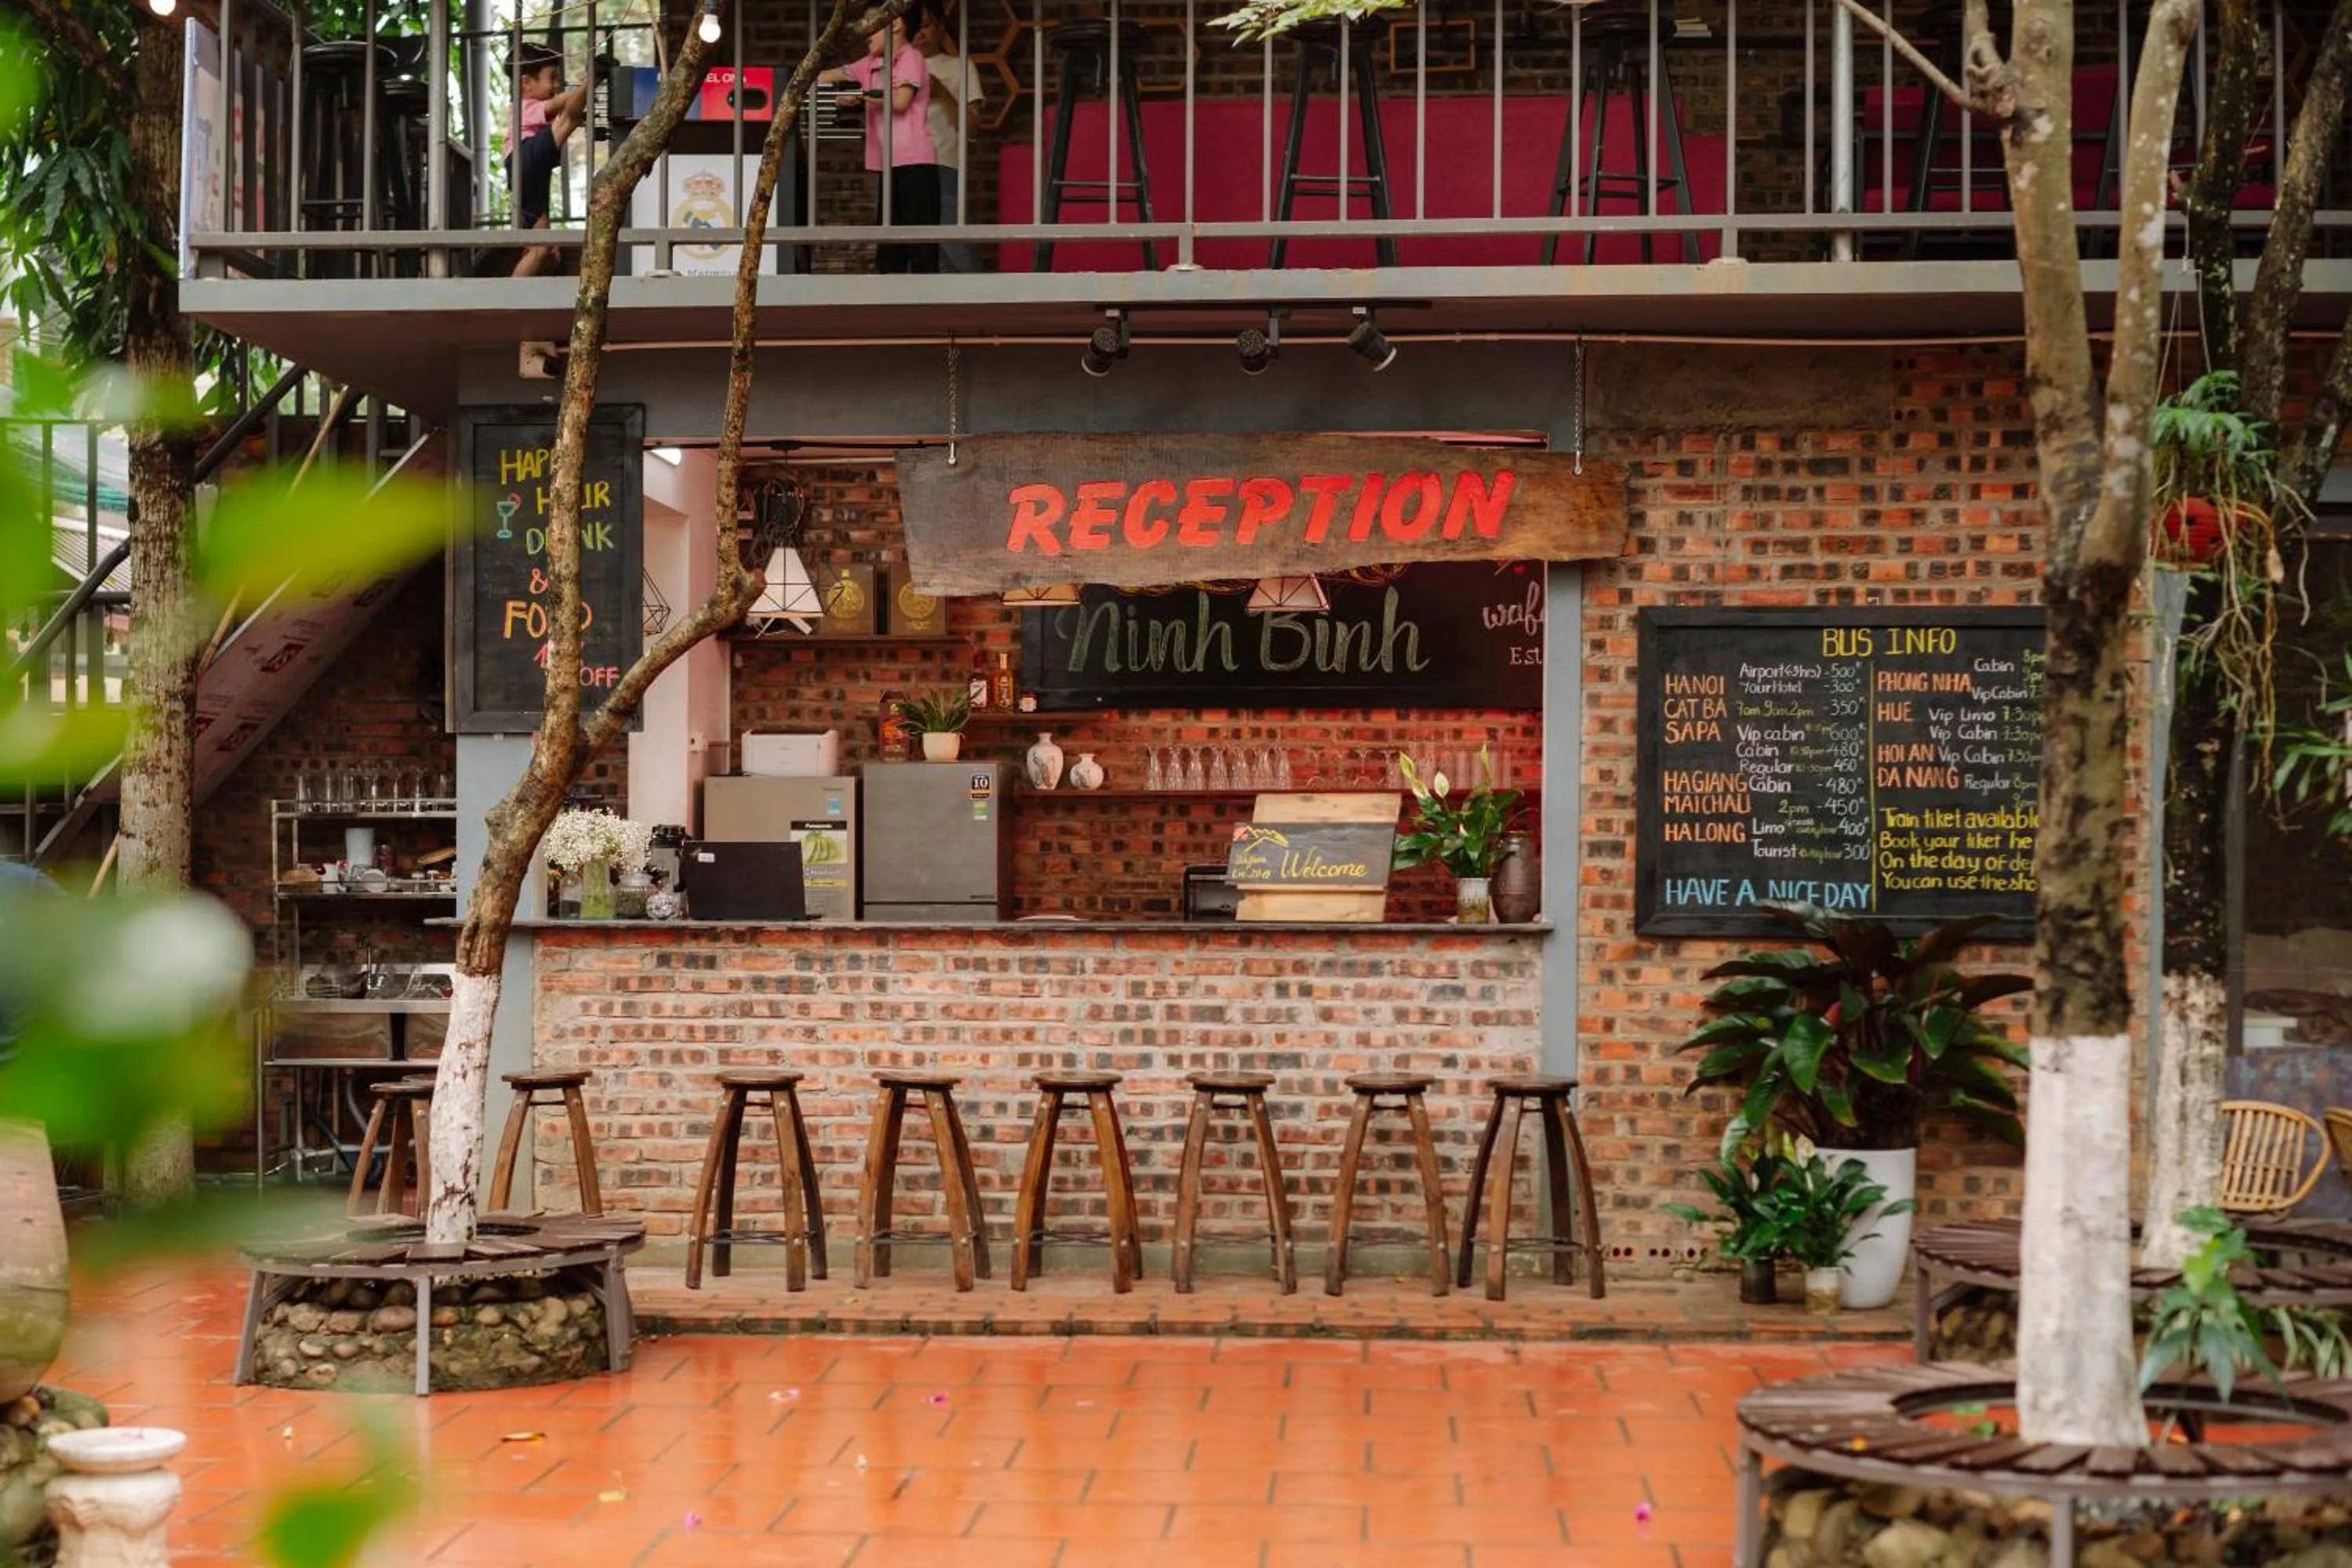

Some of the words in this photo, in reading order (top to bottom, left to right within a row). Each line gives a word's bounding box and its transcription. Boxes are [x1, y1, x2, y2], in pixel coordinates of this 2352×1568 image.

[1007, 470, 1515, 555] RECEPTION
[1822, 628, 1872, 657] BUS
[1884, 628, 1956, 655] INFO
[1974, 659, 2014, 672] Cabin
[580, 666, 620, 688] OFF
[1664, 673, 1725, 695] HANOI
[1878, 670, 1928, 691] PHONG
[1933, 672, 1973, 692] NHA
[1664, 699, 1700, 719] CAT
[1702, 699, 1727, 718] BA
[1878, 702, 1915, 722] HUE
[1929, 708, 1955, 725] Vip
[1961, 707, 1996, 722] Limo
[1664, 720, 1722, 744] SAPA
[1737, 724, 1761, 746] Vip
[1929, 725, 1951, 744] Vip
[1958, 724, 1997, 741] Cabin
[1736, 742, 1779, 758] Cabin
[1878, 743, 1904, 764] HOI
[1907, 743, 1934, 764] AN
[1937, 746, 1960, 768] Vip
[1963, 746, 2005, 764] Cabin
[1740, 758, 1792, 779] Regular
[1749, 775, 1791, 793] Cabin
[1878, 766, 1901, 787] DA
[1906, 766, 1959, 789] NANG
[1964, 771, 2010, 796] Regular
[1777, 799, 1809, 820] 2pm
[1879, 807, 1920, 829] Train
[1923, 807, 1961, 828] tiket
[1751, 817, 1786, 836] Limo
[1750, 838, 1798, 859] Tourist
[1879, 831, 1919, 849] Book
[1924, 836, 1959, 852] your
[1965, 831, 2002, 849] tiket
[1280, 845, 1368, 879] Welcome
[1879, 851, 1905, 869] On
[1910, 849, 1939, 869] the
[1940, 849, 1980, 874] day
[1984, 854, 2007, 871] of
[1665, 878, 1730, 906] HAVE
[1735, 879, 1757, 907] A
[1768, 880, 1820, 901] NICE
[1824, 881, 1871, 909] DAY
